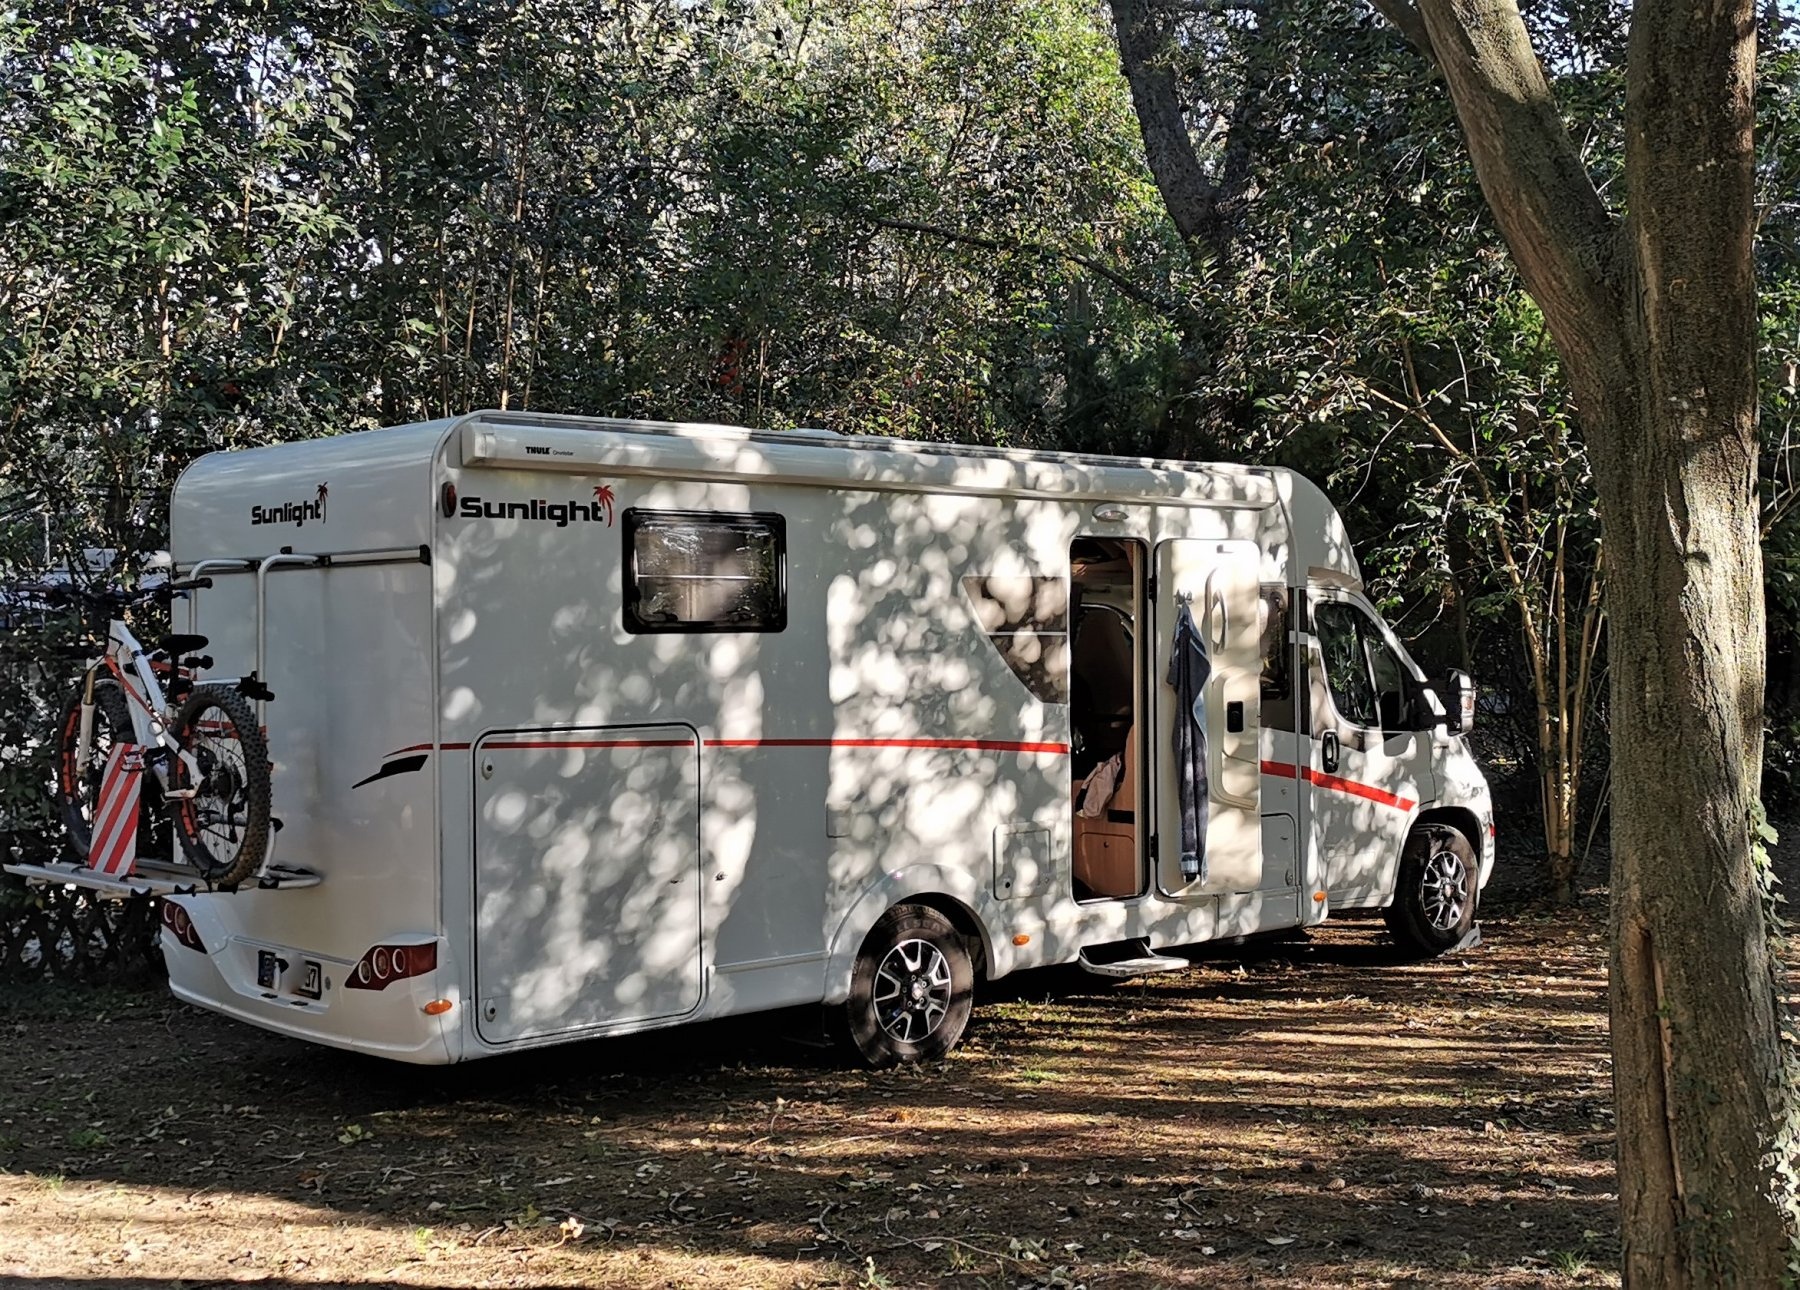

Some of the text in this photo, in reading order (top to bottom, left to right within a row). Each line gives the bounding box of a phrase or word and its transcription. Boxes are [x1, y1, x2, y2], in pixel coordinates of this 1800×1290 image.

[525, 446, 551, 455] THULE
[251, 499, 322, 528] Sunlight
[460, 496, 604, 528] Sunlight
